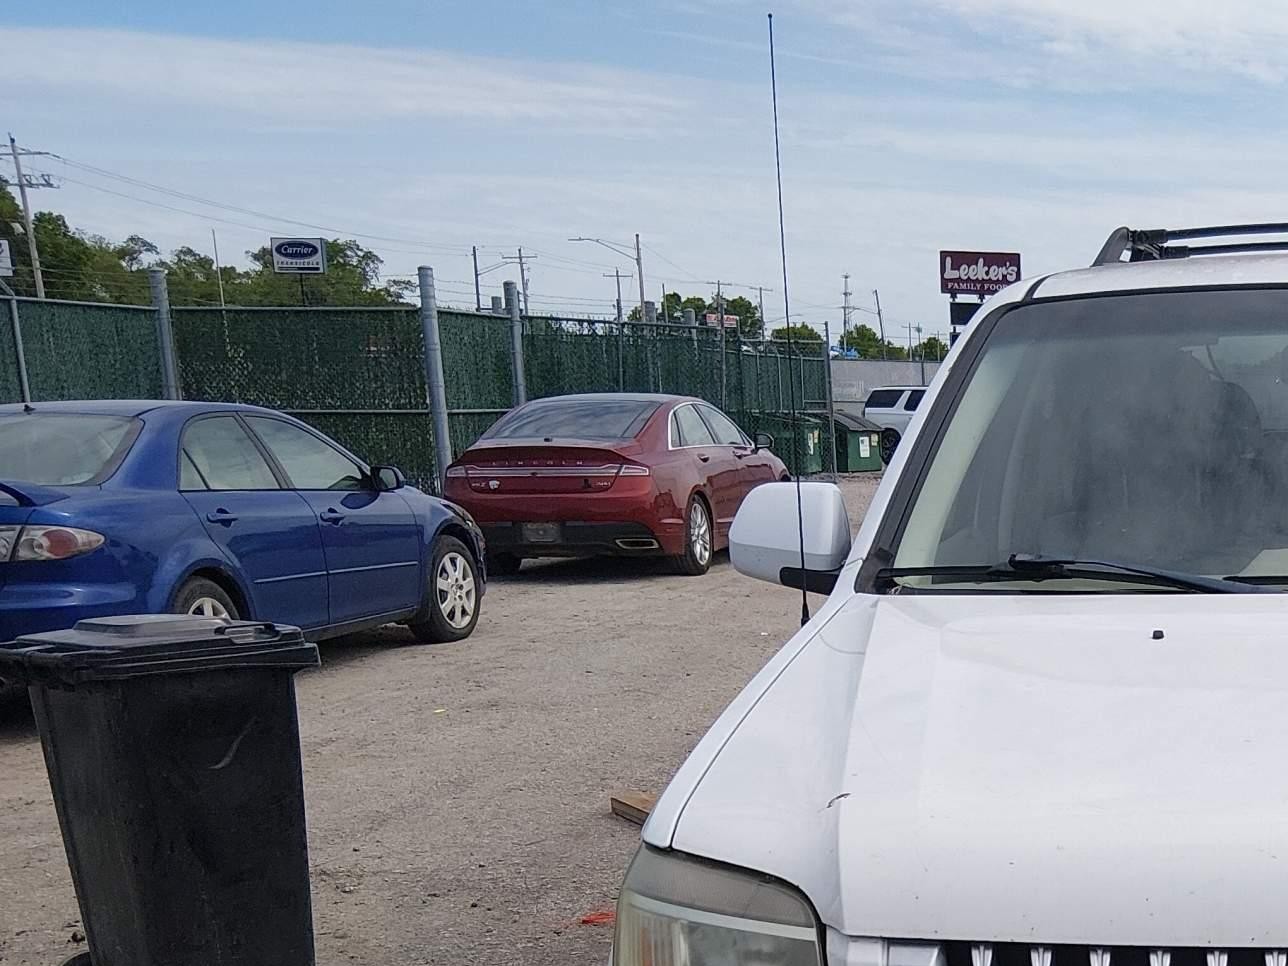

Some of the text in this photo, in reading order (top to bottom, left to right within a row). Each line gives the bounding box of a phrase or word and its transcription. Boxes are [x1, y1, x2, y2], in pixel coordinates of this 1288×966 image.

[281, 245, 313, 254] Carrier
[944, 257, 1018, 281] Leeker's
[948, 282, 981, 290] FAMILY
